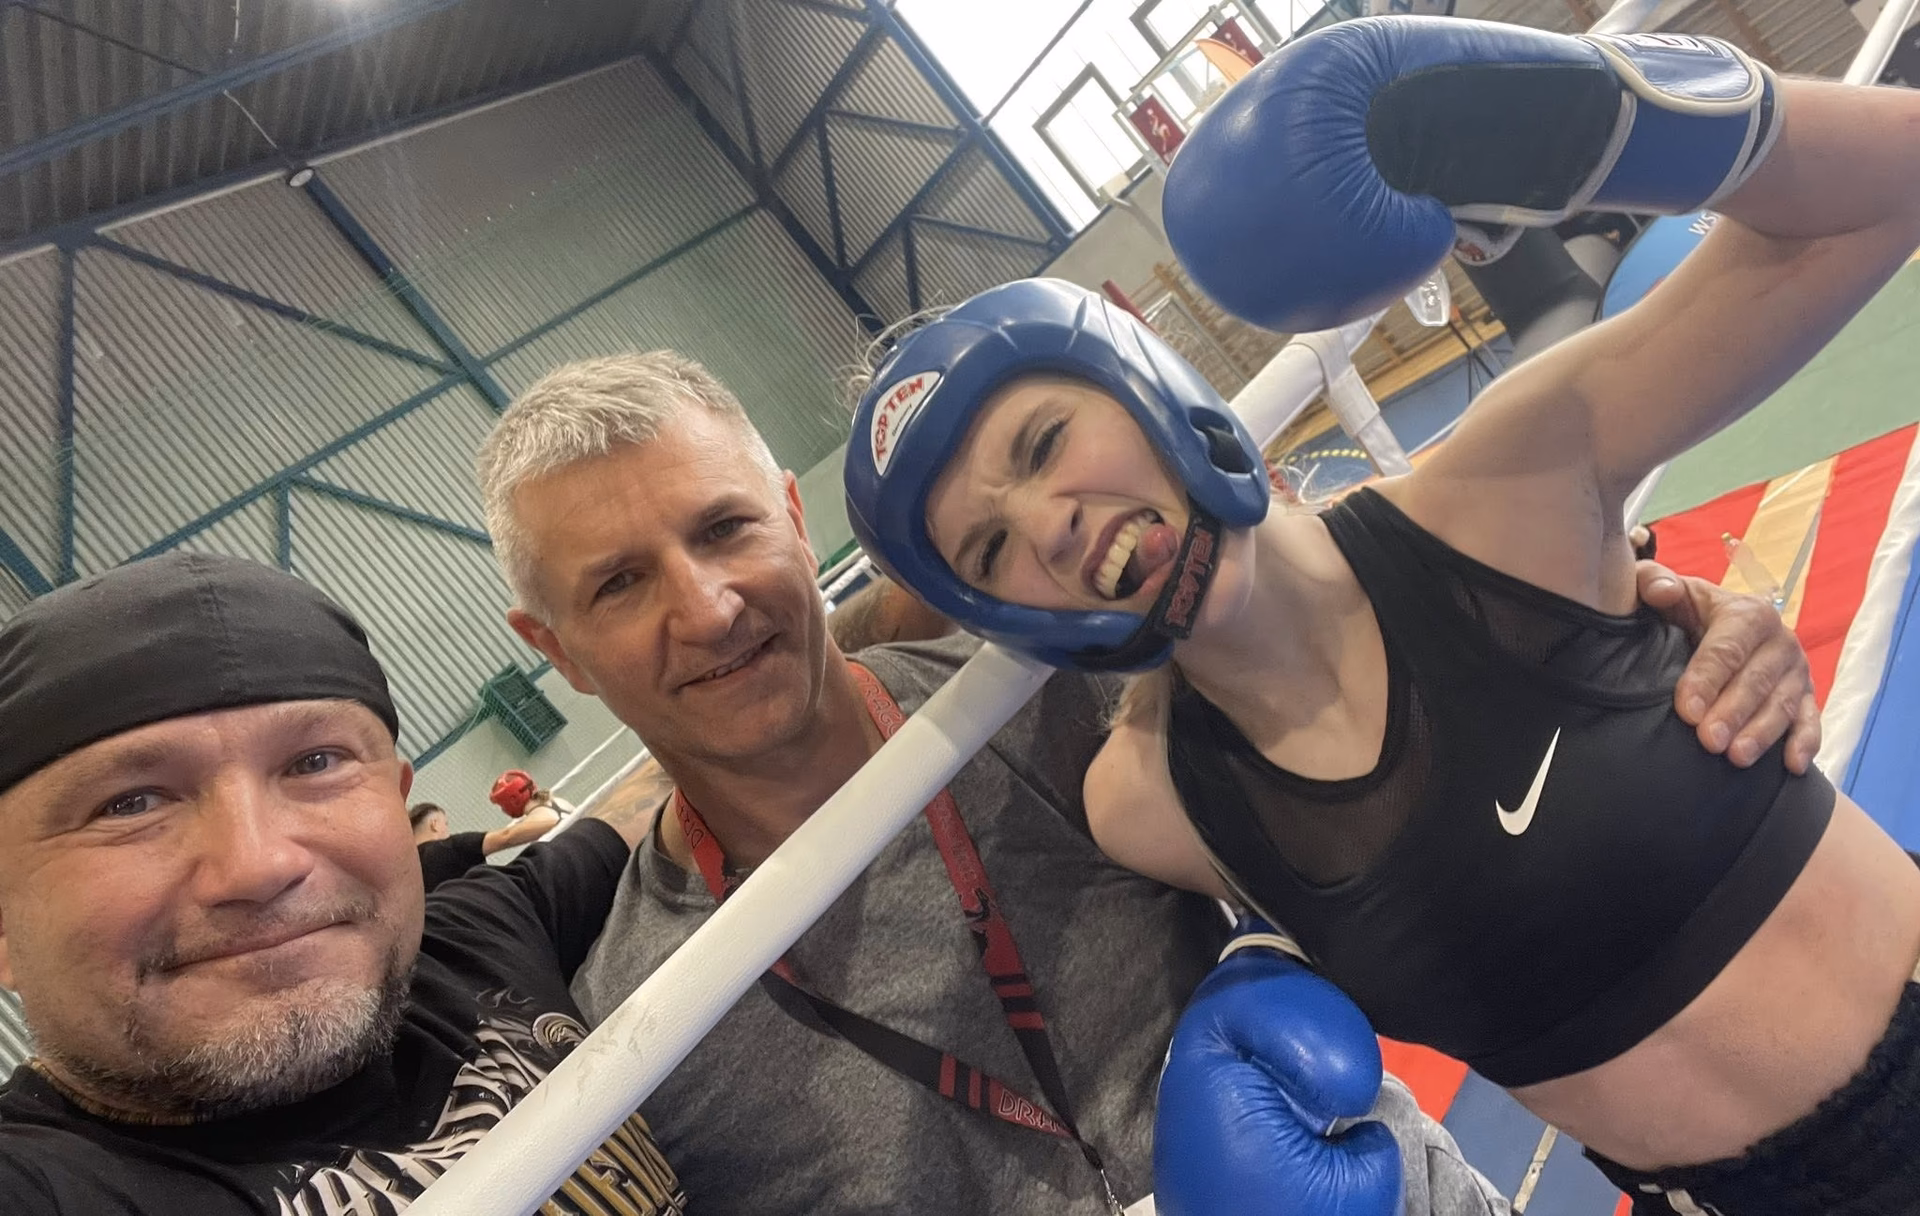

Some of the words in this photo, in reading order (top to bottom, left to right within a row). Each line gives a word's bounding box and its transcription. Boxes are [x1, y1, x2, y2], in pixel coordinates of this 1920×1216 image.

[1687, 210, 1721, 235] WS
[875, 413, 888, 462] TOP
[884, 377, 925, 412] TEN
